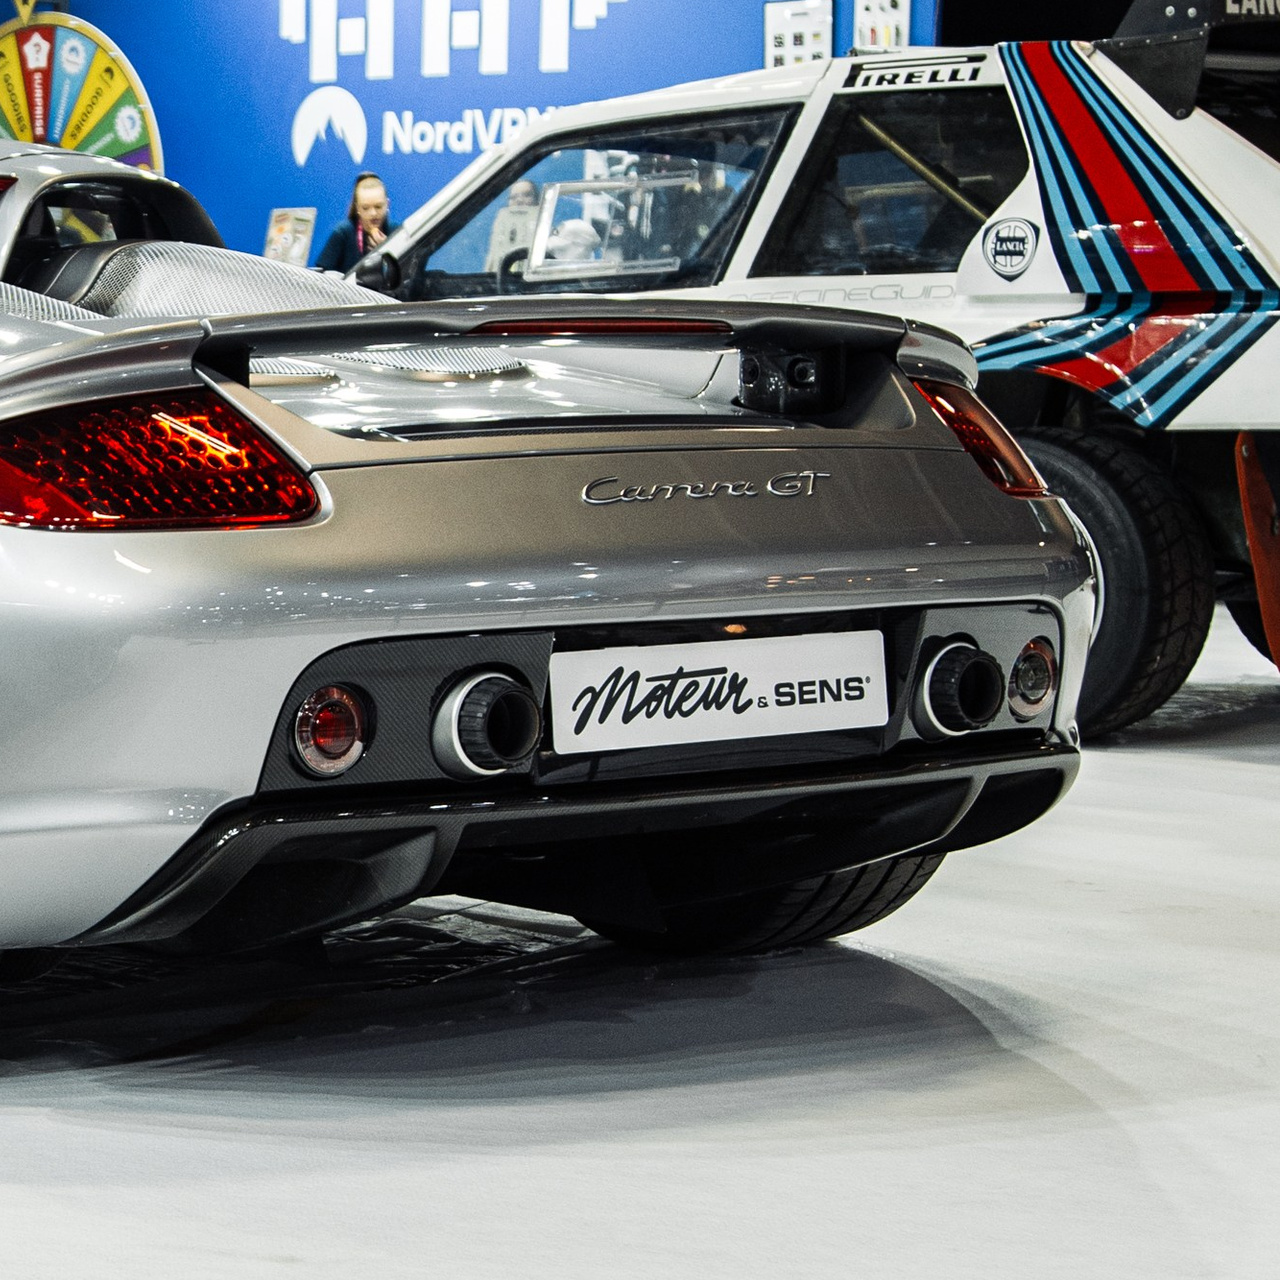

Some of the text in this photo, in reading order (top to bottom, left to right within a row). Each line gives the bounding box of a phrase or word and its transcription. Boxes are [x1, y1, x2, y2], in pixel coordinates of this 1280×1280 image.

[841, 53, 988, 88] PIRELLI
[3, 73, 26, 132] GOODIES
[33, 72, 44, 135] SURPRISE
[70, 87, 103, 140] GOODIES
[382, 106, 557, 154] NordVP
[581, 471, 831, 504] Carrera GT
[572, 666, 753, 735] Moteur
[757, 696, 769, 708] &
